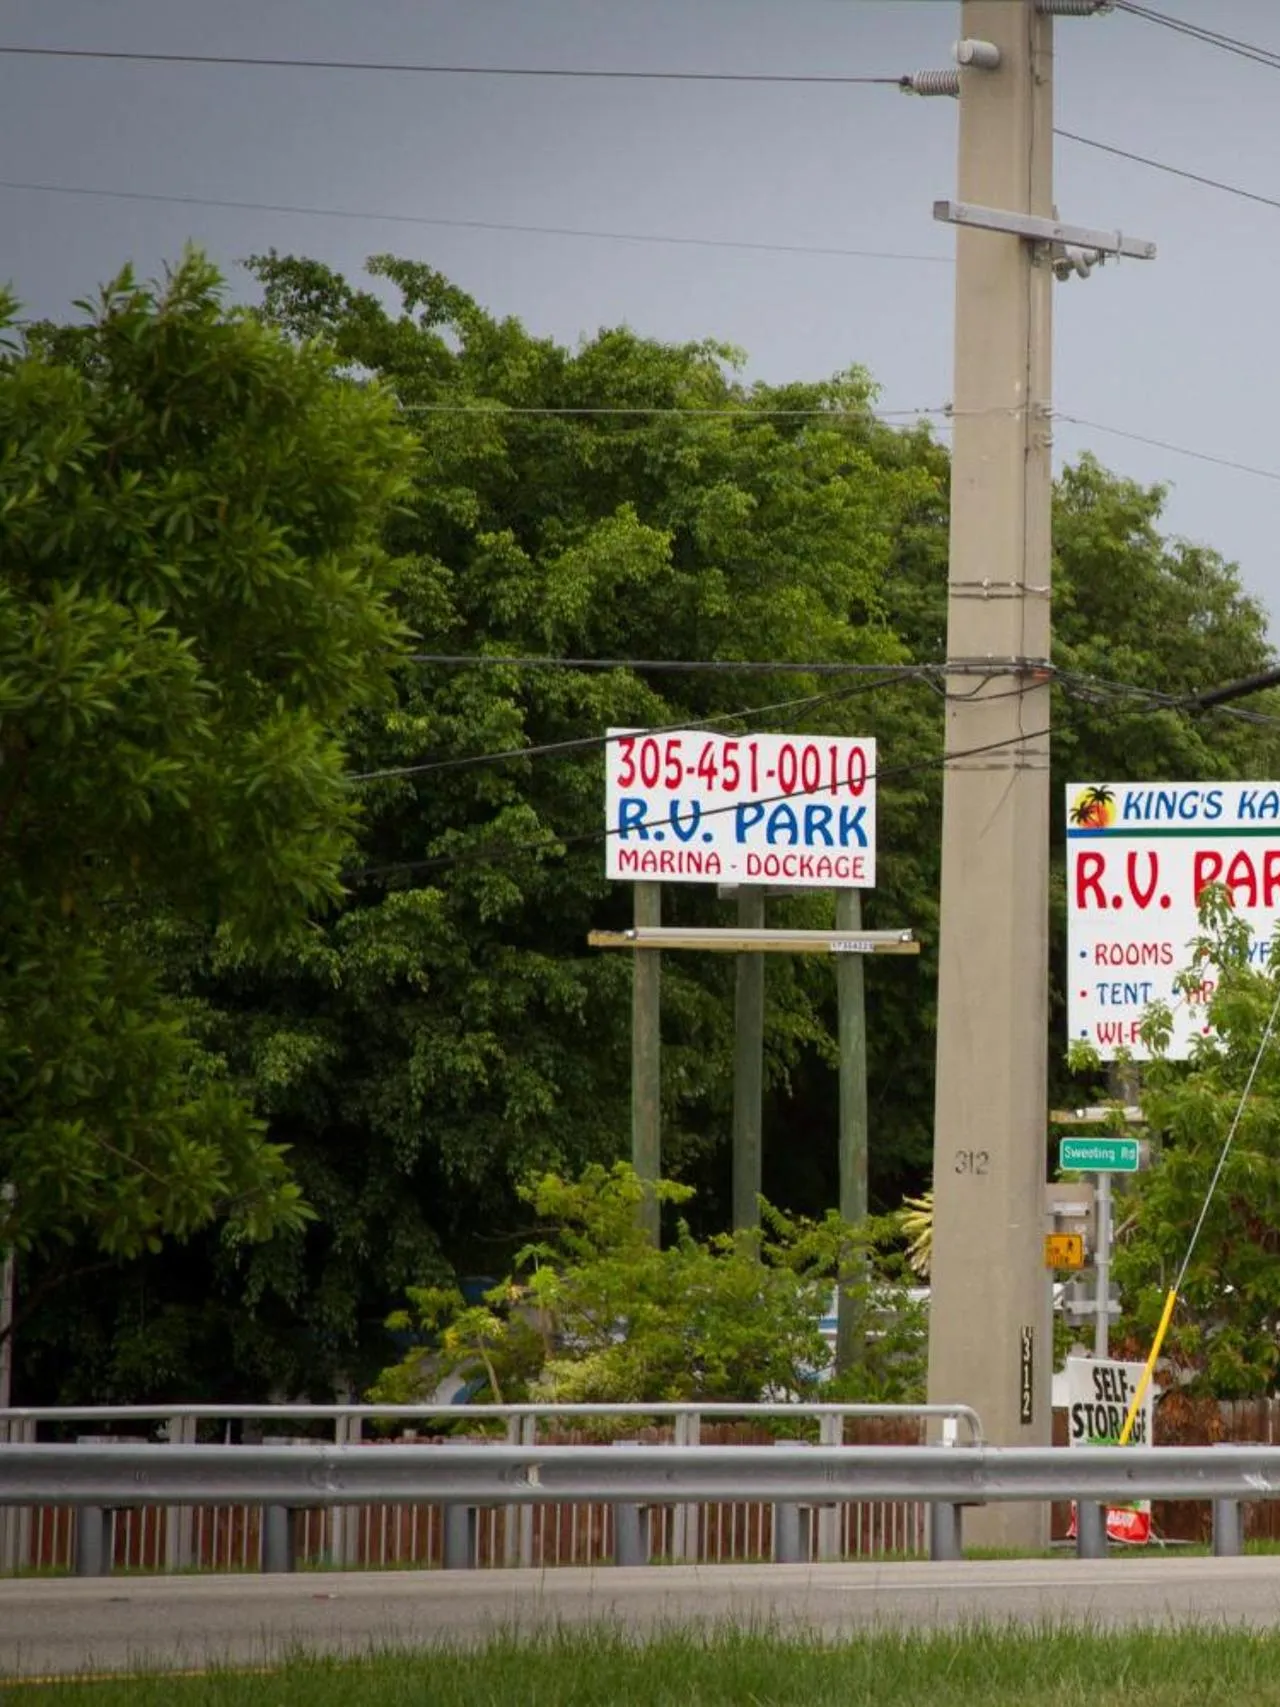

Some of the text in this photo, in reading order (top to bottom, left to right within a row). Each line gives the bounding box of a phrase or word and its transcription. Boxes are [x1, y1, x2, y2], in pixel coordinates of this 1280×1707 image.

[617, 737, 867, 797] 305-451-0010
[1122, 789, 1224, 821] KING'S
[618, 796, 868, 848] R.V. PARK
[617, 849, 721, 874] MARINA
[746, 854, 865, 879] DOCKAGE
[1075, 851, 1172, 910] R.V.
[1094, 942, 1174, 967] ROOMS
[1096, 981, 1153, 1006] TENT
[1096, 1021, 1144, 1046] WI-F
[954, 1149, 990, 1176] 312
[1121, 1146, 1136, 1161] Rd
